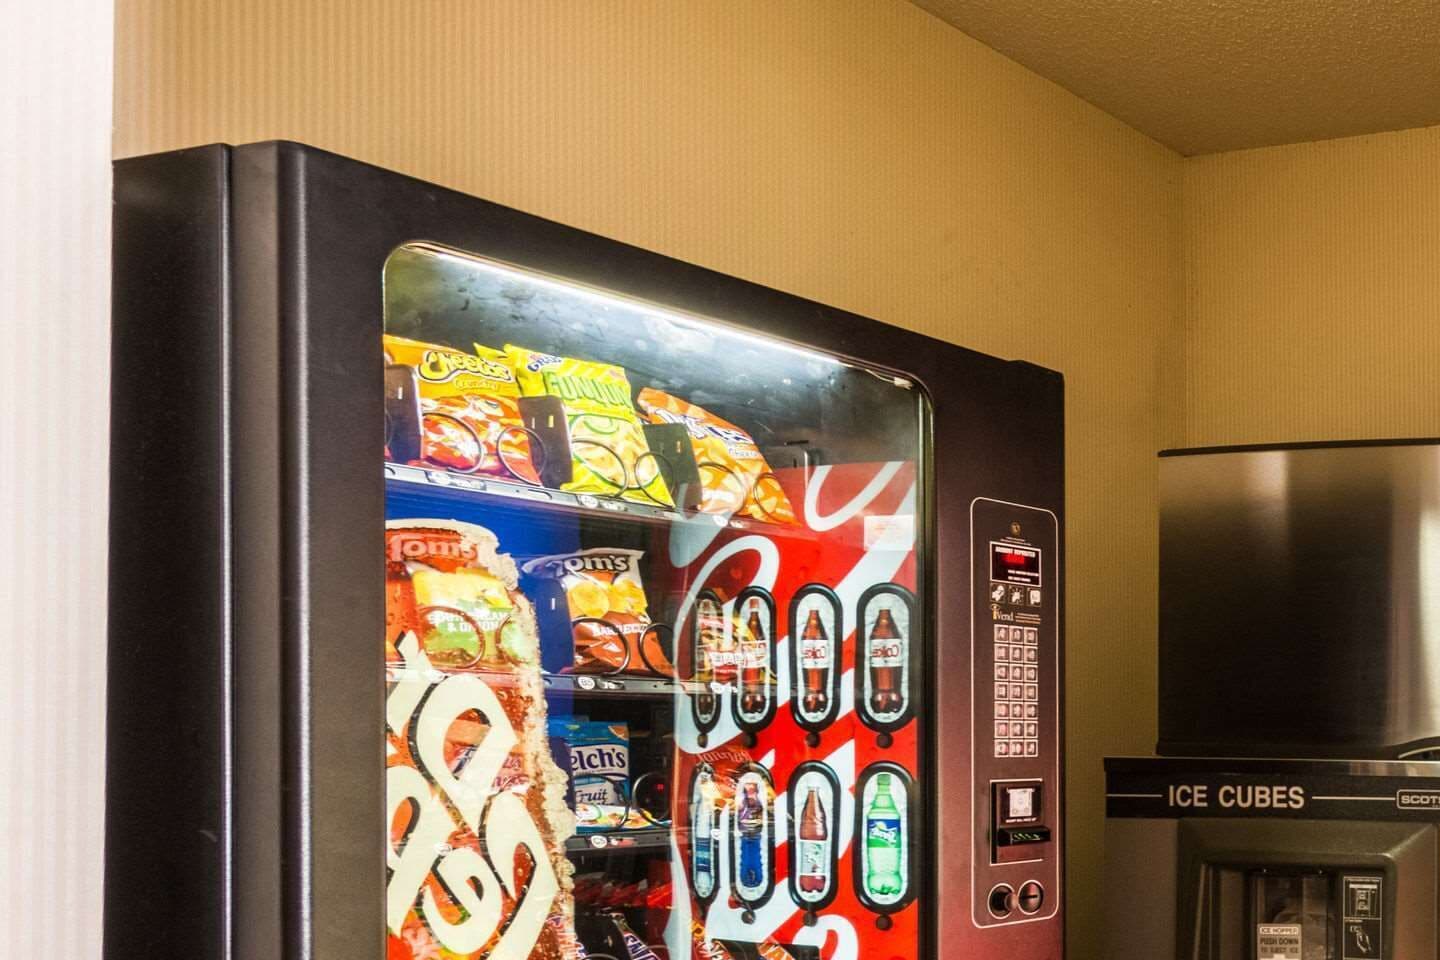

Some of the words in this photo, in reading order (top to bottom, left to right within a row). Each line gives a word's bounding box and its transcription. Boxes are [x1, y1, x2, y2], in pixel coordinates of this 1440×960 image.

[419, 351, 511, 380] Cheetos
[571, 748, 626, 771] elch's
[1169, 785, 1207, 808] ICE
[1218, 786, 1305, 809] CUBES
